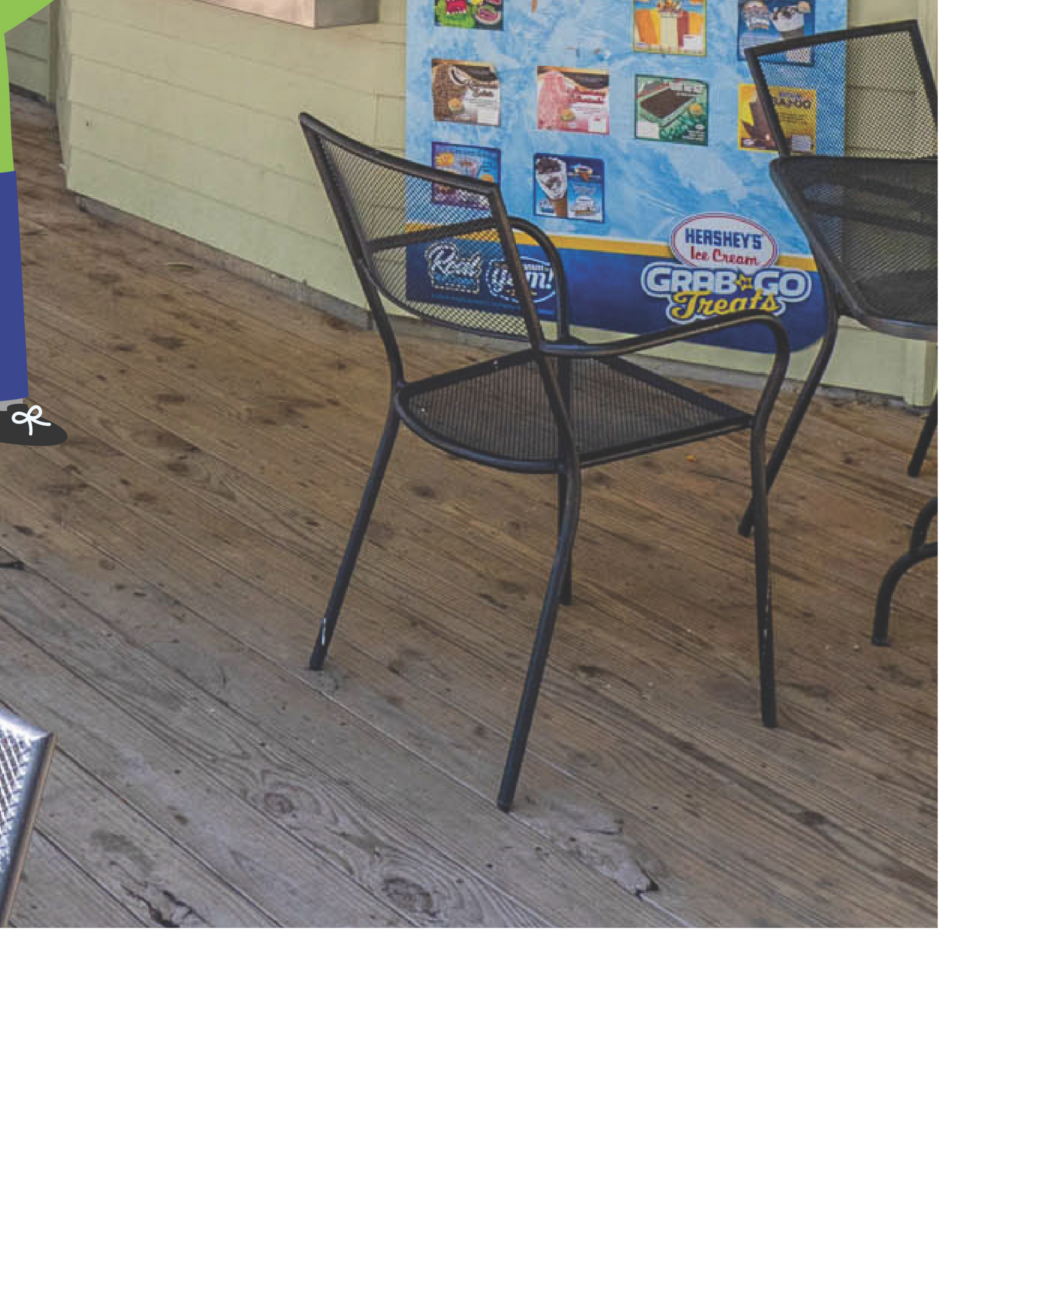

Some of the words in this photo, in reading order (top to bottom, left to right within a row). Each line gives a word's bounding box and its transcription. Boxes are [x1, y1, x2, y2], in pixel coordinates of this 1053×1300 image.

[684, 228, 763, 250] HERSHEY'S
[690, 245, 710, 262] Ice
[712, 248, 758, 266] Cream
[646, 267, 739, 295] GRAB
[754, 269, 807, 296] GO
[670, 288, 781, 319] Treats
